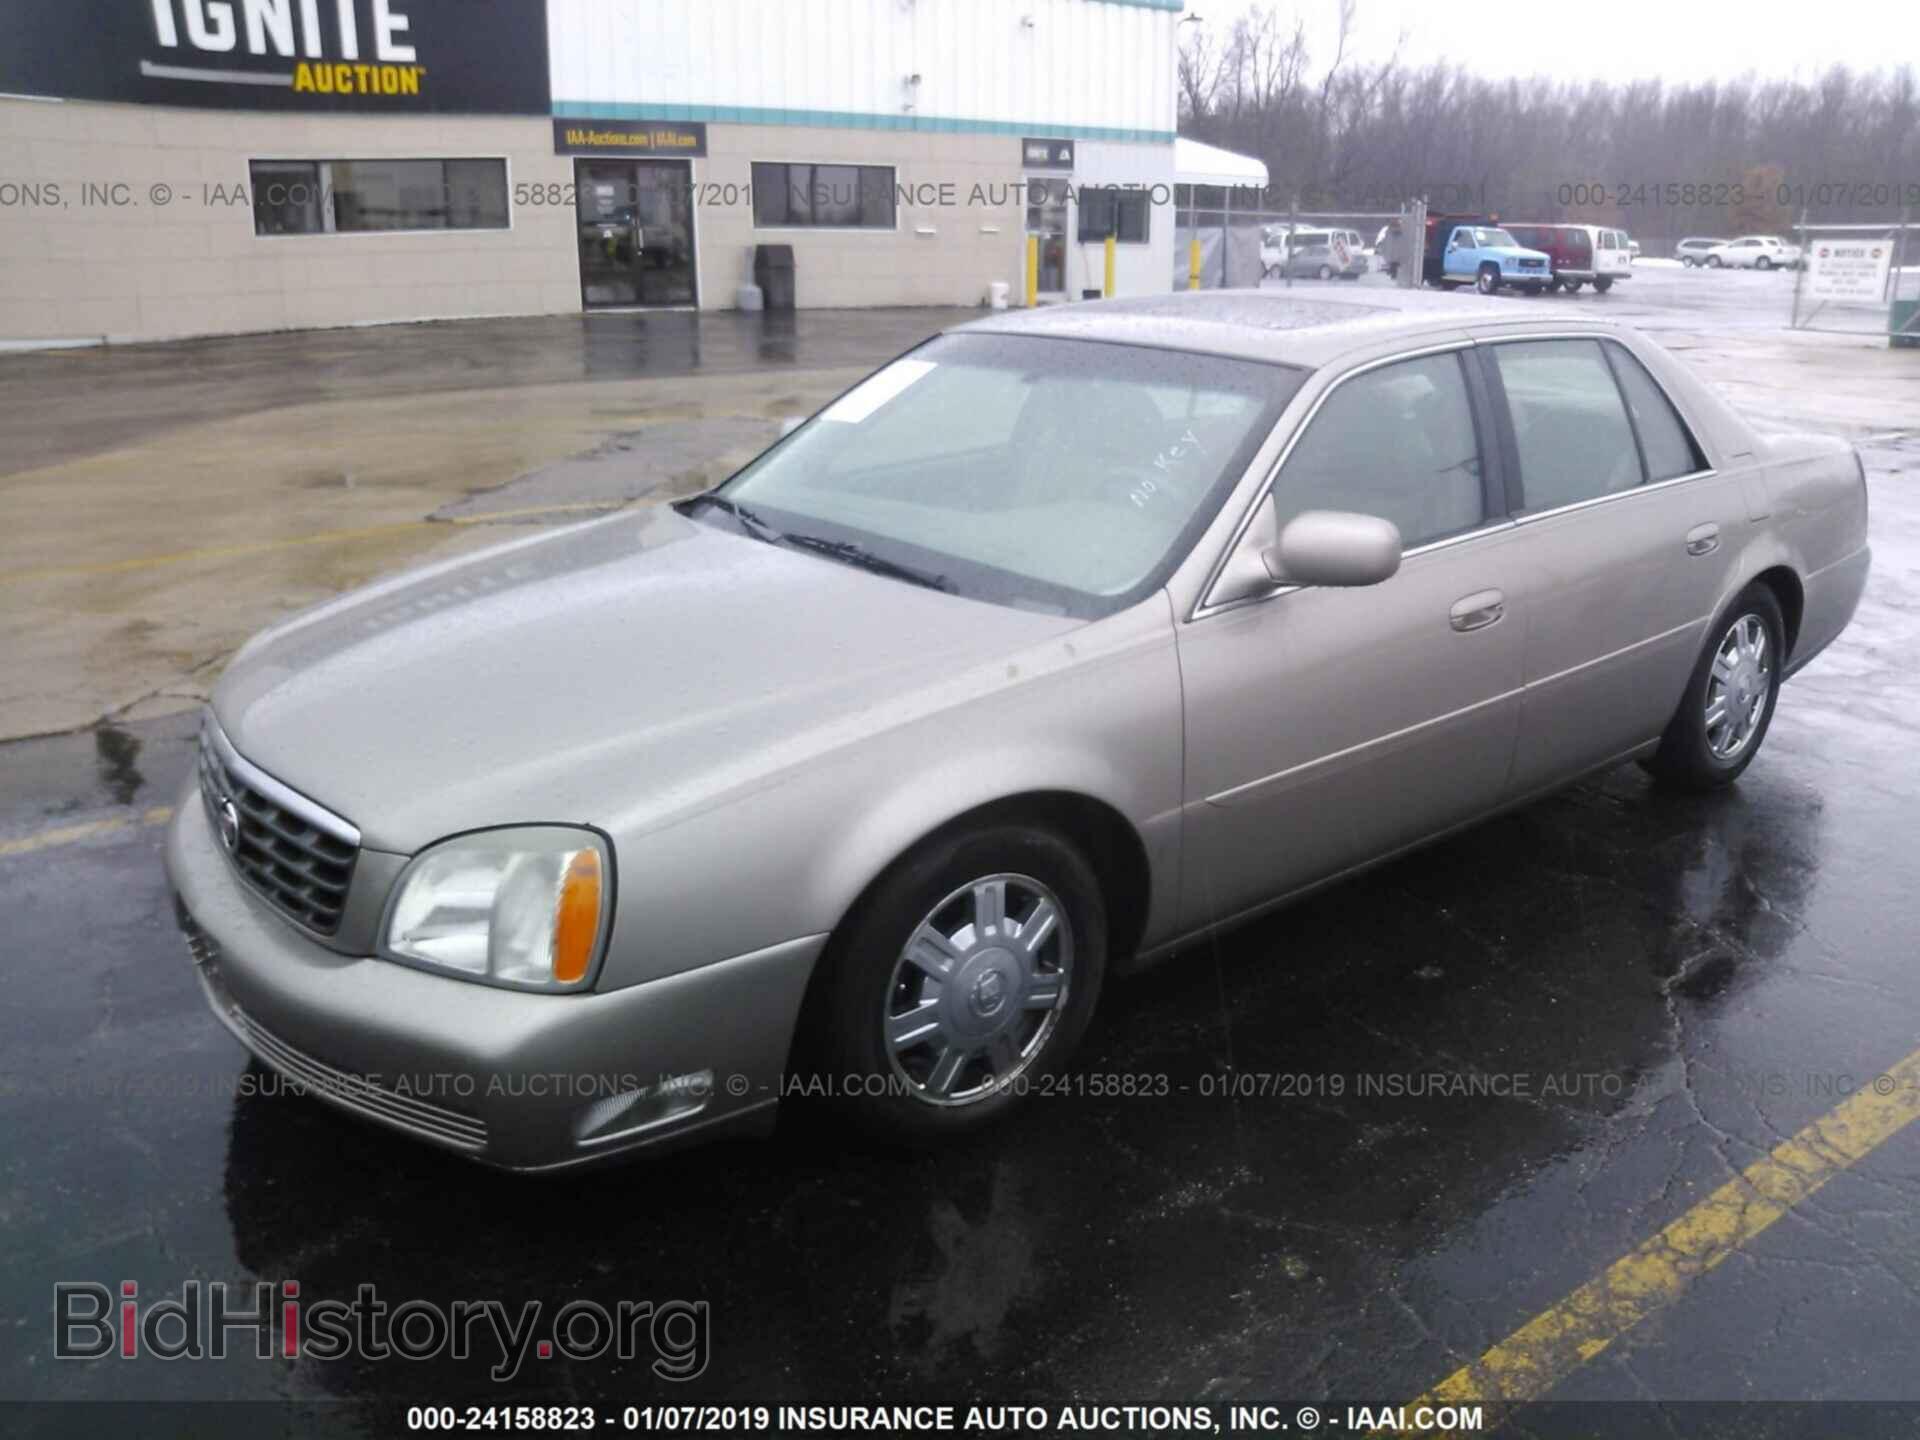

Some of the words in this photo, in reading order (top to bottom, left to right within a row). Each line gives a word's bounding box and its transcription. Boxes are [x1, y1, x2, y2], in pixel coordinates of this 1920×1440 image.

[150, 0, 417, 62] IGNITE
[293, 63, 420, 95] AUCTION
[565, 129, 649, 146] IAA-Auctions.com
